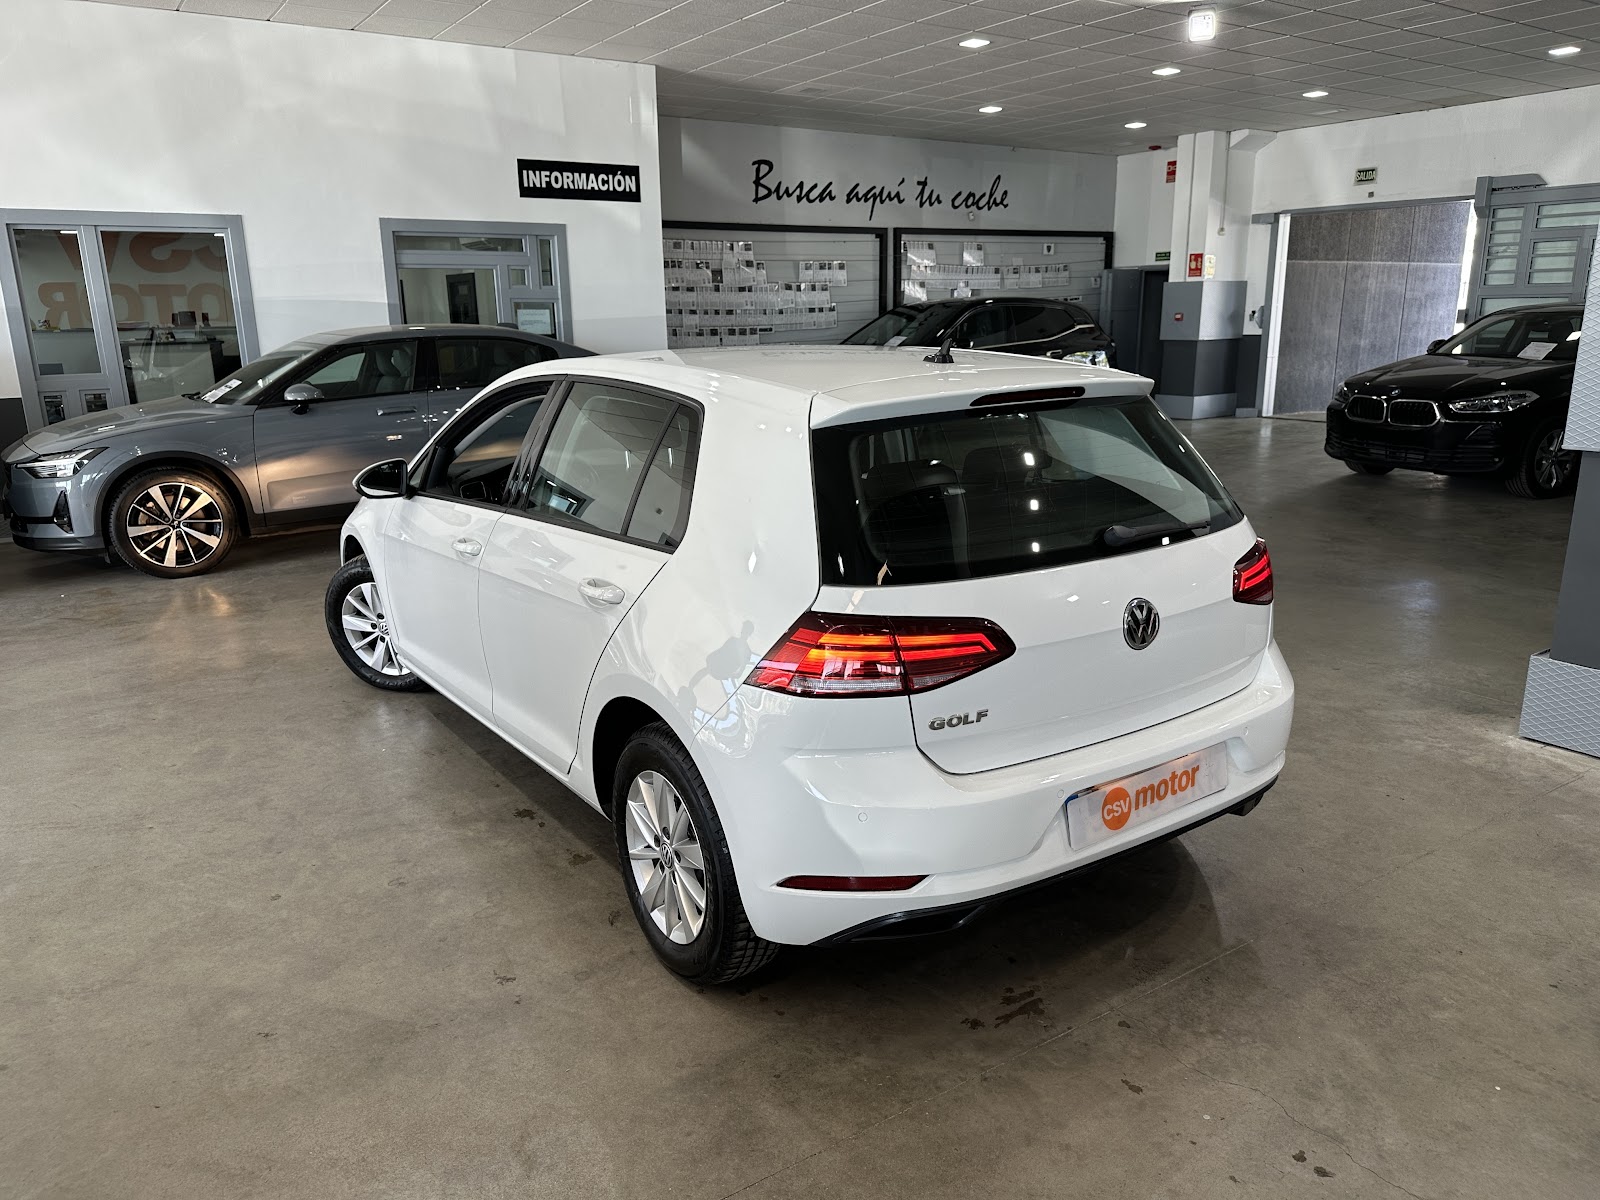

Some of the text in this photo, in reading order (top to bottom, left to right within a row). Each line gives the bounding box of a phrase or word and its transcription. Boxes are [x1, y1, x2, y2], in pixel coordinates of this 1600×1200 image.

[522, 170, 637, 192] INFORMACIÓN
[752, 159, 1009, 221] Busca aquí tu coche
[1356, 170, 1376, 181] SALIDA
[1123, 597, 1160, 650] VW
[928, 708, 989, 731] GOLF
[1103, 764, 1200, 820] CSV motor
